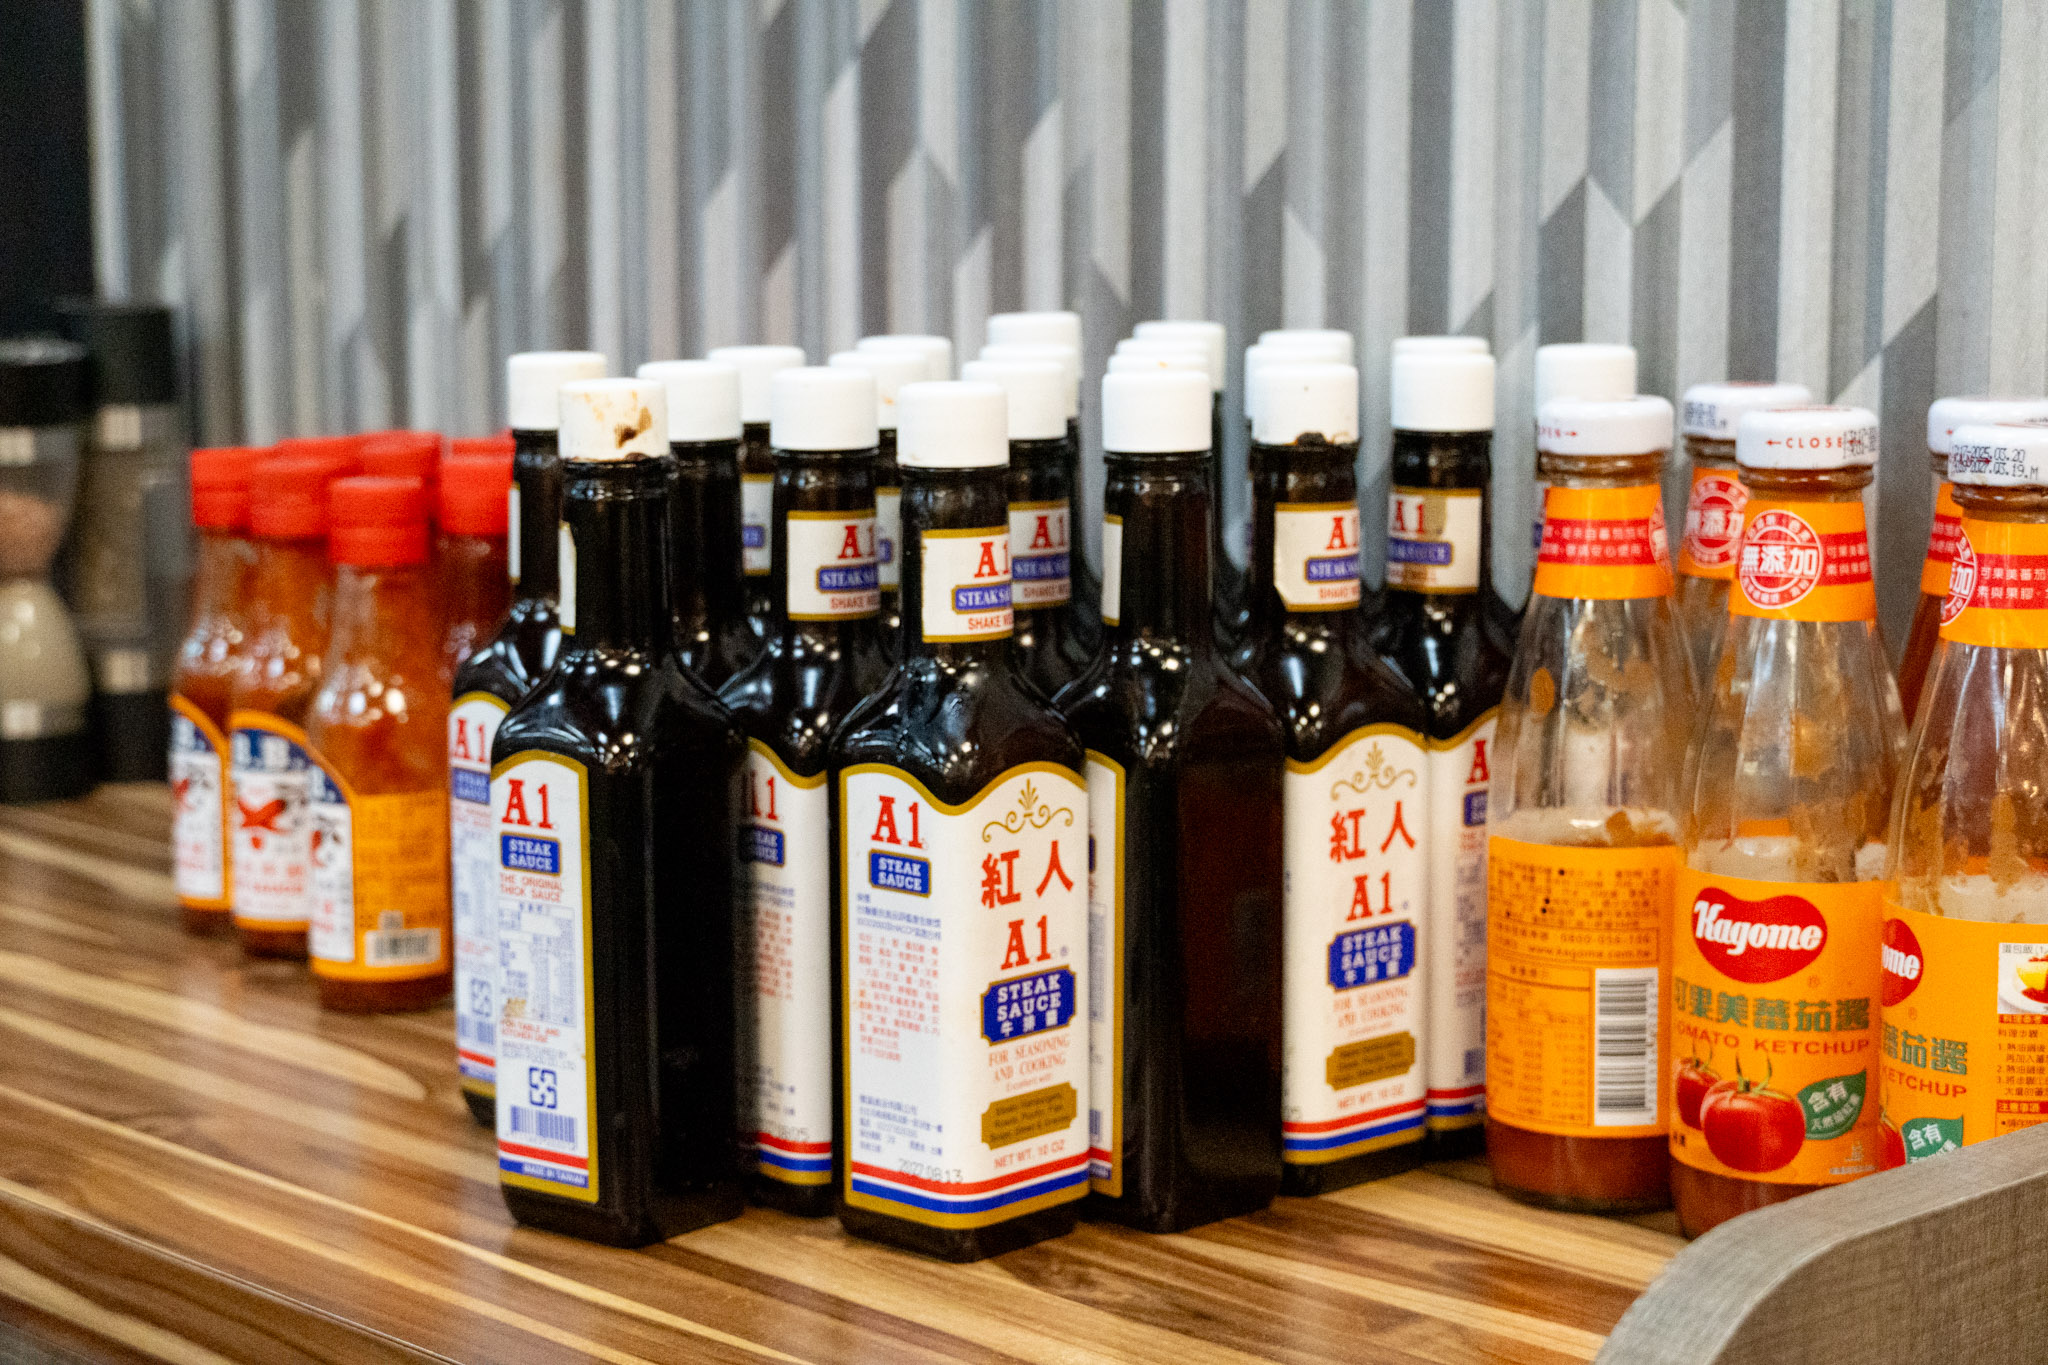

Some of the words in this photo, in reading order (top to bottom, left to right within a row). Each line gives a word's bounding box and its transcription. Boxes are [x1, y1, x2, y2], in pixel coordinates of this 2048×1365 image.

[1786, 437, 1842, 448] CLOSE
[1029, 516, 1064, 549] A1
[974, 541, 1009, 578] A1
[1741, 545, 1818, 576] 無添加
[958, 589, 999, 607] STEAK
[968, 616, 1000, 630] SHAKE
[454, 717, 487, 763] A1
[502, 778, 553, 829] A1
[871, 795, 923, 849] A1
[1330, 801, 1415, 862] 紅人
[508, 852, 553, 871] SAUCE
[509, 838, 552, 856] STEAK
[878, 857, 921, 877] STEAK
[878, 872, 922, 891] SAUCE
[982, 840, 1073, 909] 紅人
[522, 875, 563, 892] ORIGINAL
[532, 887, 561, 902] SAUCE
[1346, 872, 1393, 921] A1
[1001, 915, 1051, 970] A1
[1342, 926, 1402, 953] STEAK
[1694, 900, 1823, 956] Kagome
[1341, 942, 1402, 971] SAUCE
[997, 974, 1061, 1003] STEAK
[997, 993, 1061, 1022] SAUCE
[989, 1049, 1009, 1067] FOR
[1016, 1034, 1070, 1059] SEASONING
[1754, 1038, 1870, 1055] KETCHUP
[994, 1064, 1014, 1081] AND
[1019, 1051, 1066, 1076] COOKING
[1807, 1081, 1848, 1113] 含有
[1908, 1123, 1942, 1150] 含有
[994, 1153, 1014, 1168] NET
